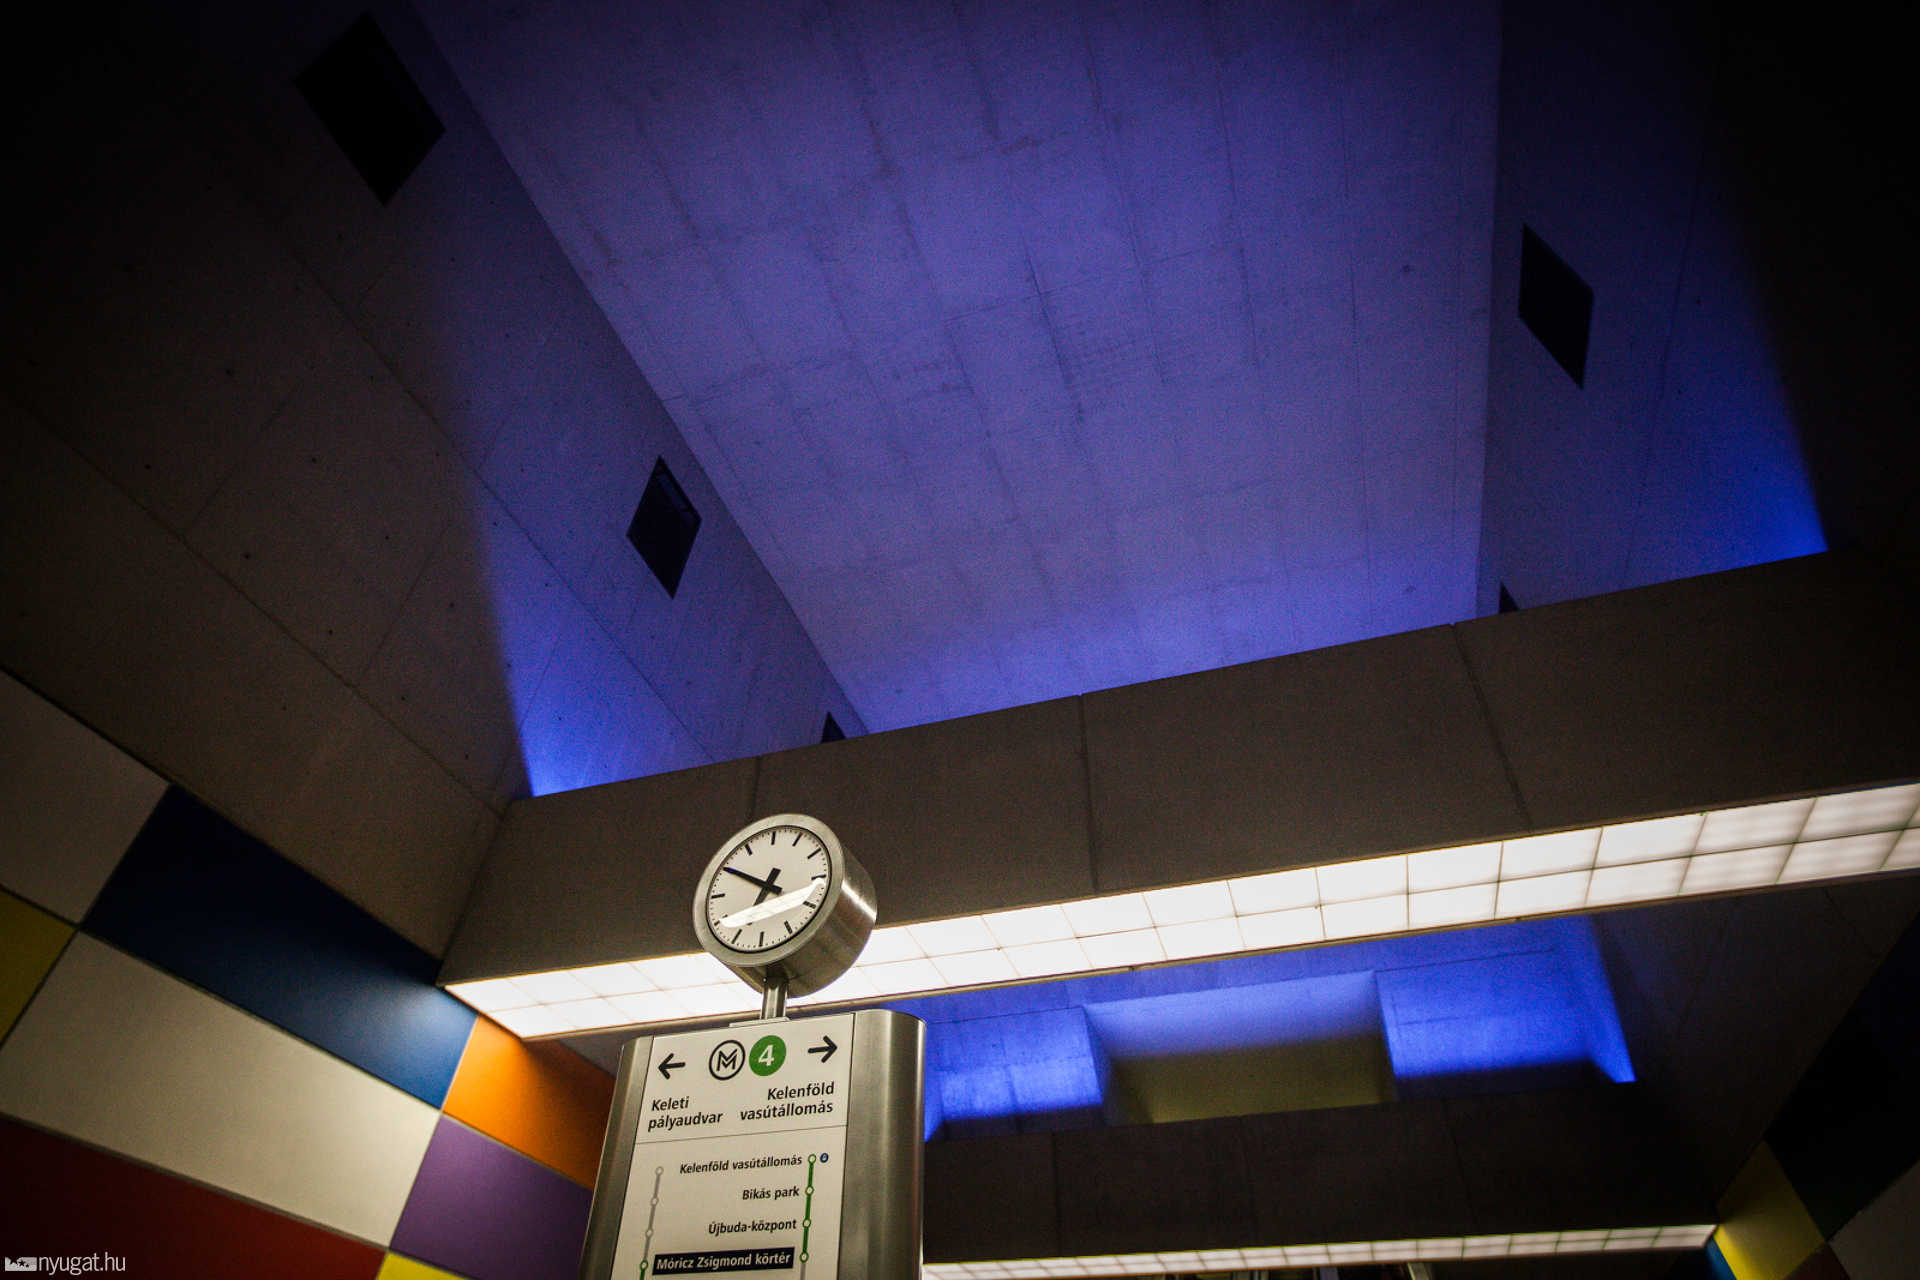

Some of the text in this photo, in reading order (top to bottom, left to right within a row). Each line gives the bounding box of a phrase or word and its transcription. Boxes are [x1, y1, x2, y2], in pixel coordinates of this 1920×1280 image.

[758, 1044, 775, 1067] 4
[767, 1081, 835, 1101] Kelenföld
[651, 1096, 690, 1112] Keleti
[740, 1101, 833, 1121] vasútállomás
[647, 1112, 723, 1133] pályaudvar
[679, 1155, 803, 1174] Kelenföld vasútállomás
[742, 1186, 800, 1200] Bikás park
[708, 1219, 797, 1237] Újbuda-központ
[656, 1252, 791, 1271] Móricz Zsigmond körtér
